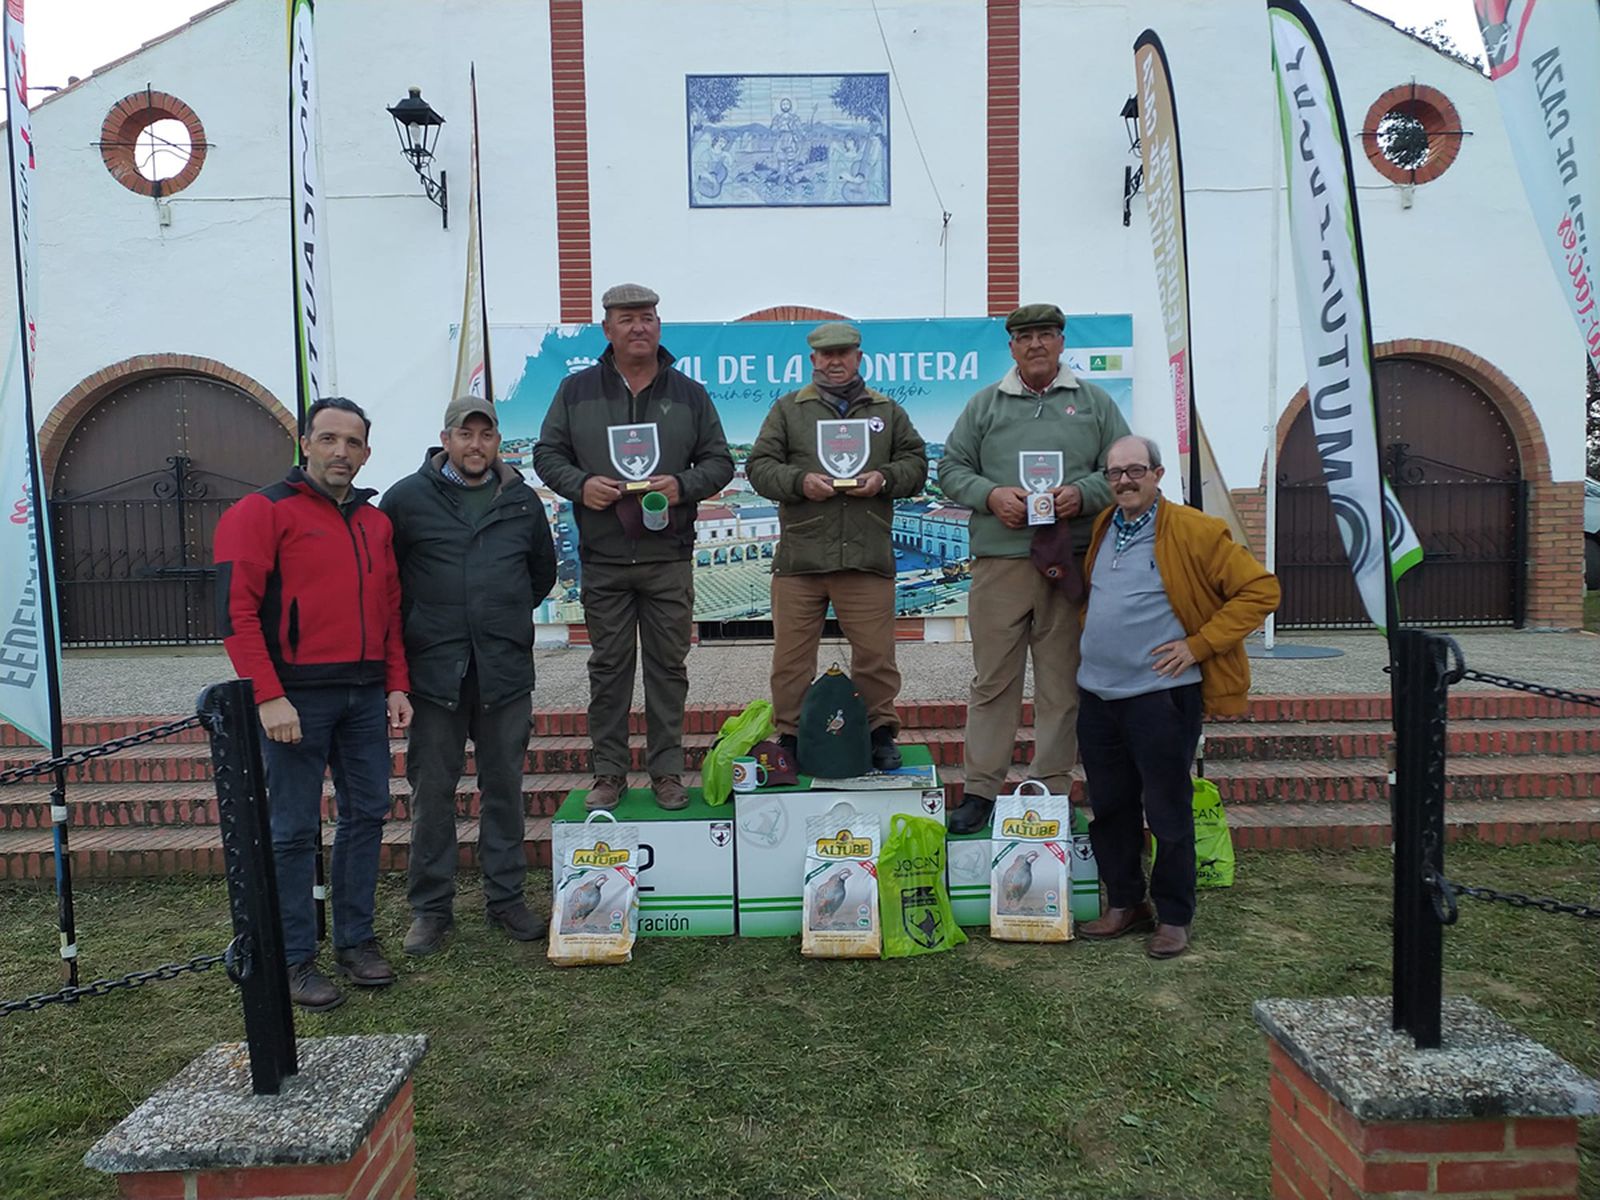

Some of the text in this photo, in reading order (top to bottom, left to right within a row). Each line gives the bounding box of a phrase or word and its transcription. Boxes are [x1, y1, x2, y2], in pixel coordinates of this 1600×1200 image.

[718, 355, 757, 385] DE
[766, 354, 803, 384] LA
[861, 350, 979, 382] ONTERA
[1005, 824, 1057, 837] ALTUBE
[819, 843, 869, 856] ALTUBE
[575, 854, 627, 866] ALTUBE
[638, 913, 690, 932] ración
